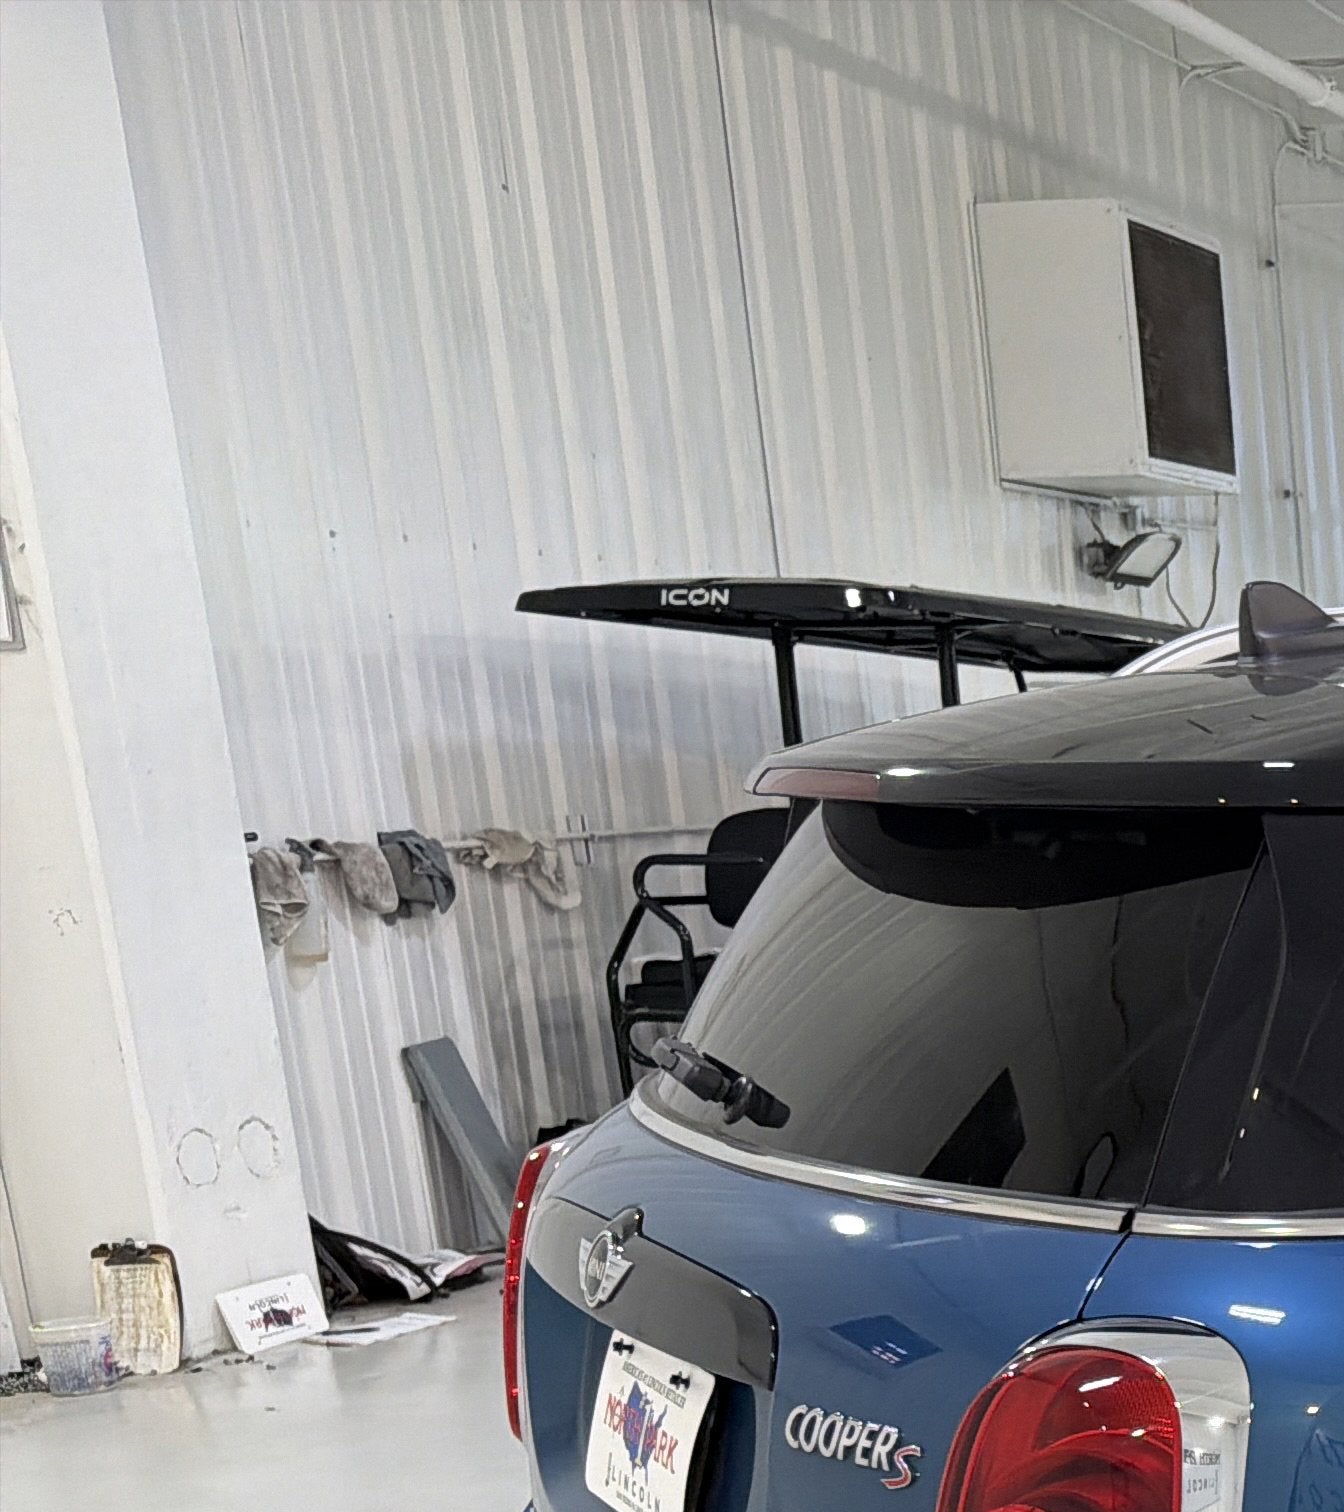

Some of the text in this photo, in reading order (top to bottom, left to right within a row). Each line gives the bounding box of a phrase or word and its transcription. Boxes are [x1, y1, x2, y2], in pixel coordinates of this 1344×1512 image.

[660, 588, 730, 607] ICON
[784, 1404, 921, 1490] COOPER S
